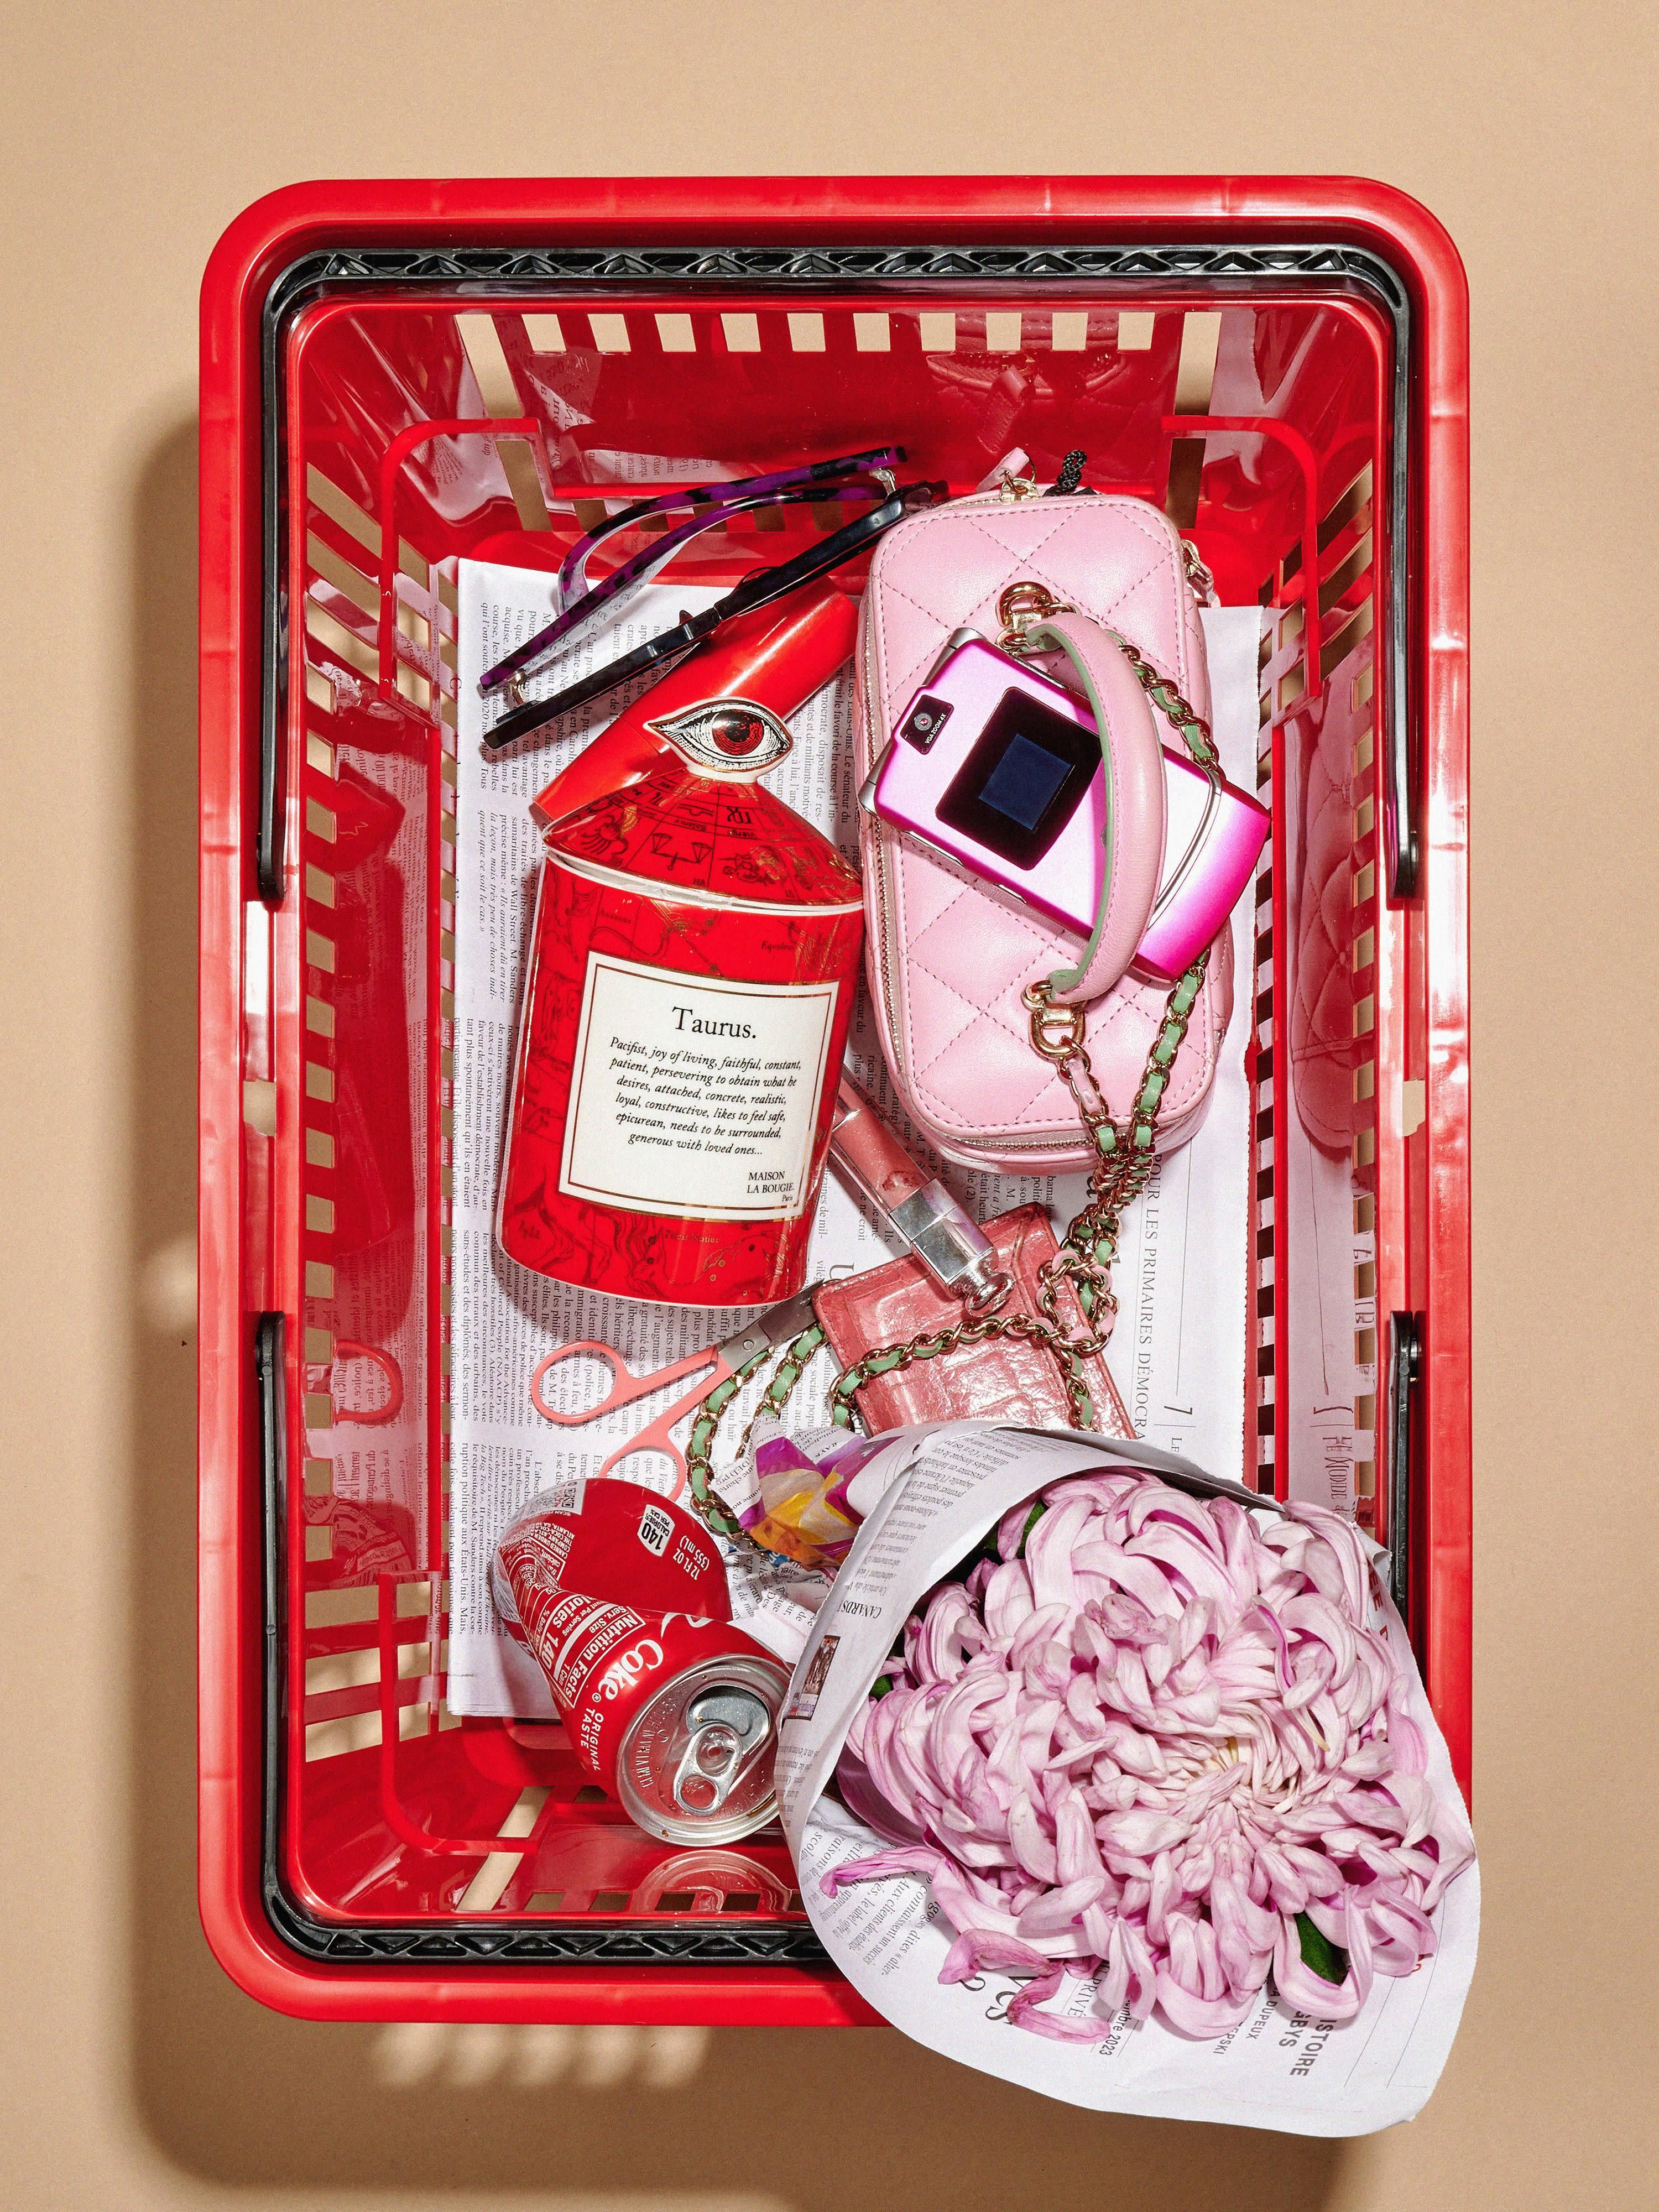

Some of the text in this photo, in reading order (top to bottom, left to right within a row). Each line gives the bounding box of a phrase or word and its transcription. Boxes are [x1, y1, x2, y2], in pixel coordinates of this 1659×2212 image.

[833, 677, 844, 698] était
[833, 711, 843, 738] favori
[925, 713, 947, 744] VGA ZOOM 4X
[832, 739, 841, 750] de
[832, 753, 841, 761] la
[816, 739, 828, 784] disposait
[481, 766, 489, 789] Tous
[841, 755, 853, 823] Le sénateur du
[817, 787, 827, 800] de
[511, 874, 519, 886] de
[511, 889, 519, 911] Wall
[511, 948, 518, 962] M.
[509, 966, 518, 1004] Sanders
[672, 1006, 756, 1039] Taurus.
[464, 1039, 474, 1059] plus
[610, 1036, 801, 1072] Pacifist, joy of living, faithful, constant,
[609, 1057, 797, 1087] patient, persevering to obtain what he
[463, 1062, 474, 1128] spontanément
[617, 1075, 786, 1105] desires, attached, concrete, realistic,
[615, 1092, 786, 1125] loyal, constructive, likes to feel safe,
[615, 1113, 781, 1139] epicurean, needs to be surrounded,
[628, 1134, 674, 1146] generous
[677, 1139, 702, 1151] with
[704, 1141, 734, 1154] loved
[464, 1161, 469, 1173] en
[748, 1171, 785, 1181] MAISON
[463, 1176, 472, 1208] étaient
[747, 1185, 759, 1193] LA
[821, 1208, 829, 1218] de
[1144, 1208, 1160, 1240] LES
[819, 1220, 828, 1239] mil-
[858, 1219, 868, 1241] croit
[463, 1229, 472, 1282] sans-études
[463, 1285, 470, 1294] et
[1139, 1247, 1157, 1345] PRIMAIRES
[463, 1297, 471, 1312] des
[461, 1314, 471, 1360] diplômés,
[639, 1309, 650, 1344] gratuité
[597, 1360, 608, 1396] thèmes
[1134, 1352, 1155, 1439] DÉMOCRA
[1164, 1404, 1193, 1416] 7
[460, 1443, 470, 1477] ruption
[460, 1481, 470, 1525] politique
[553, 1523, 575, 1540] ATLANTA,
[645, 1514, 670, 1537] CALORIES
[650, 1509, 670, 1527] PER CAN
[534, 1533, 568, 1559] CANNED UNDER
[535, 1525, 572, 1547] THE COCA-COLA
[549, 1532, 570, 1552] COMPANY,
[641, 1522, 664, 1550] 140
[672, 1548, 700, 1580] 12 FL OZ
[680, 1535, 709, 1571] (355 mL)
[461, 1549, 471, 1602] États-Unis.
[460, 1608, 469, 1634] Mais,
[562, 1600, 608, 1637] ount Per Serving
[604, 1605, 628, 1619] Serv.
[843, 1600, 882, 1619] CANARDS
[541, 1595, 594, 1670] lories 140
[589, 1619, 607, 1634] Size
[565, 1614, 638, 1698] Nutrition Facts
[598, 1639, 664, 1700] Coke
[559, 1670, 568, 1686] Can
[581, 1708, 596, 1749] TASTE
[589, 1713, 604, 1771] ORIGINAL
[820, 1835, 847, 1870] raisons
[892, 1877, 911, 1899] Aux
[852, 1907, 867, 1926] label
[862, 1898, 875, 1908] le
[874, 1898, 896, 1926] clients
[915, 1901, 941, 1930] gogies
[863, 1885, 928, 1965] connaissent un succès
[863, 1923, 878, 1935] des
[899, 1929, 921, 1953] dites
[1067, 1976, 1103, 2018] PRIVÉ
[1099, 1998, 1131, 2057] embre 2023
[1246, 2000, 1278, 2039] DUPEUX
[1279, 2010, 1312, 2047] GBYS
[1213, 2026, 1240, 2055] EPSKI
[1290, 2019, 1337, 2077] ISTOIRE
